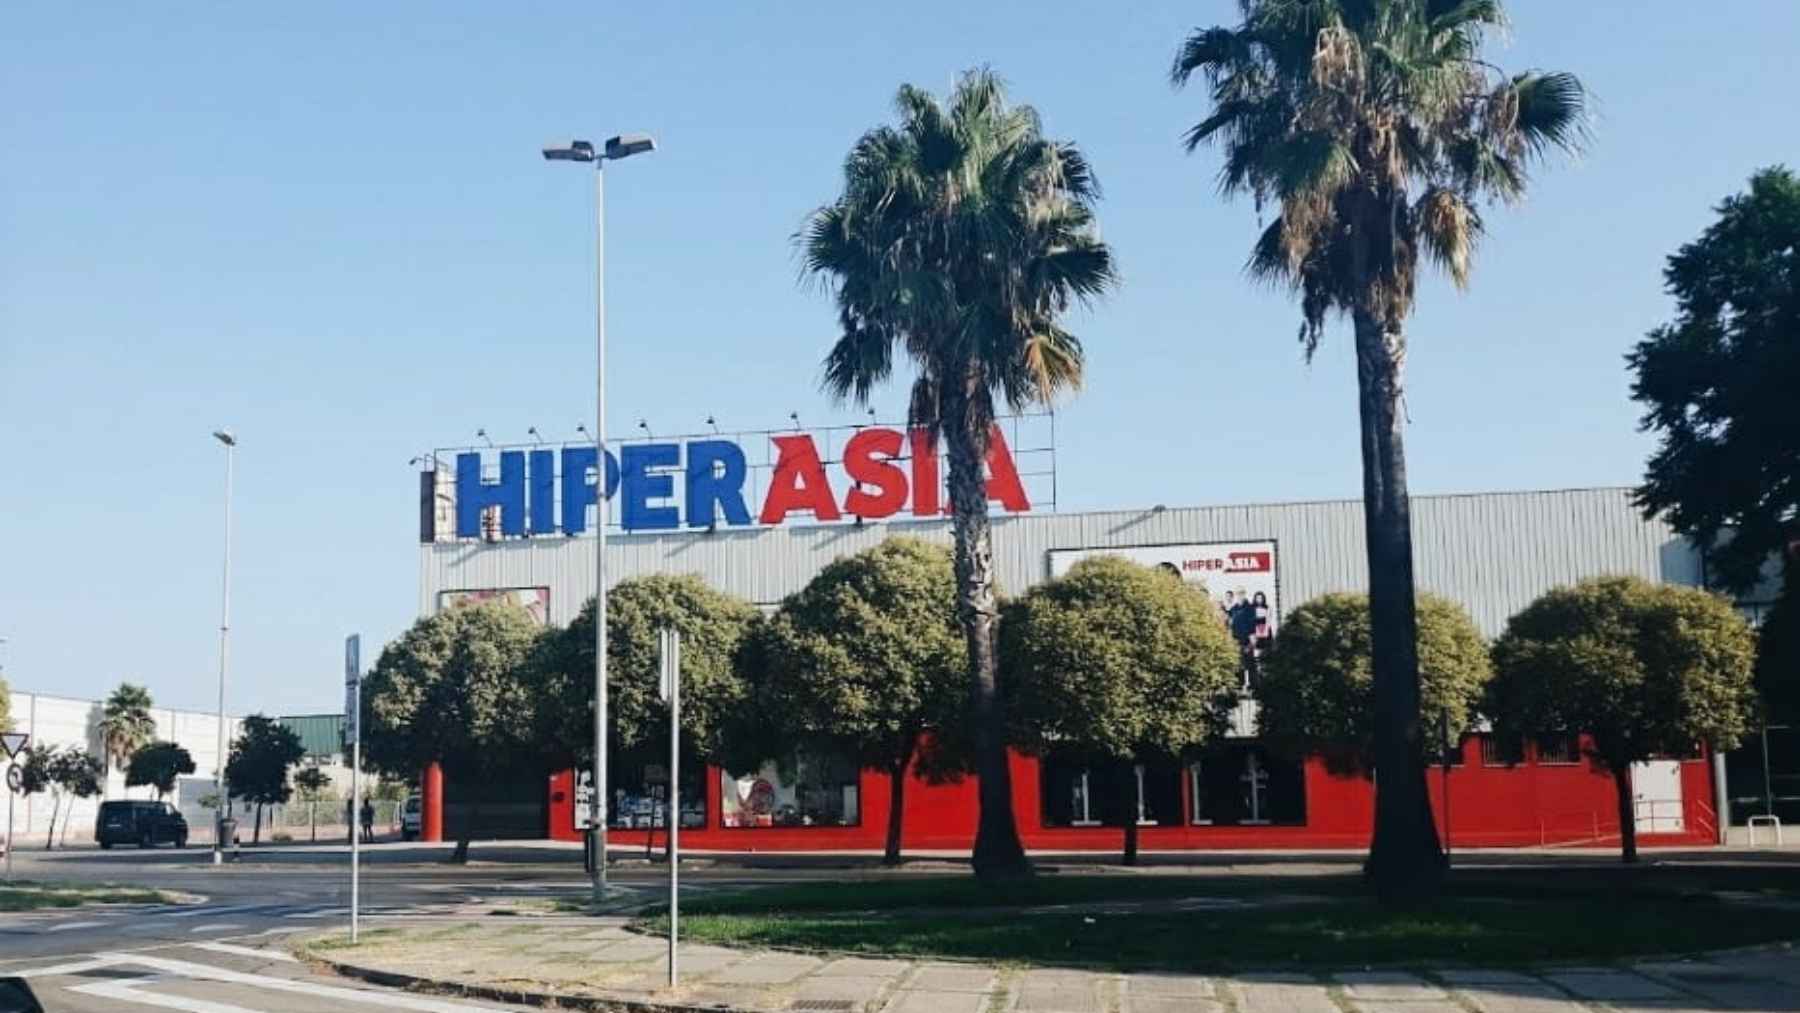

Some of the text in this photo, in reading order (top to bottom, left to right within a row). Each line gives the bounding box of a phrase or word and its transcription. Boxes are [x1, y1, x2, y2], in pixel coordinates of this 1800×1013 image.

[455, 440, 751, 538] HIPER
[1182, 557, 1260, 570] HIPER ASIA
